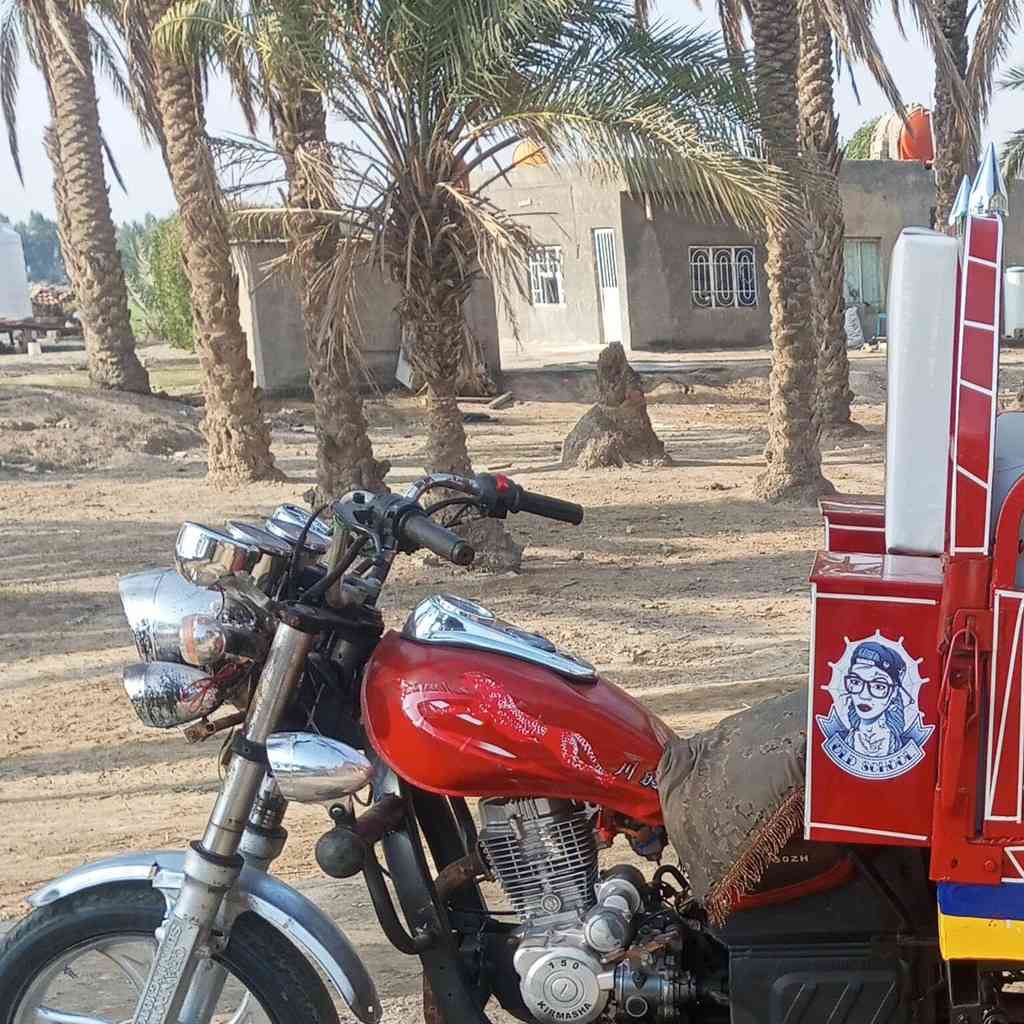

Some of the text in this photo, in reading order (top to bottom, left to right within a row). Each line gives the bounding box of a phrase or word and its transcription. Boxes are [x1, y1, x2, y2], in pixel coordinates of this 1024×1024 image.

[831, 743, 915, 773] OLD SCHOOL
[547, 959, 580, 970] 150
[536, 1000, 593, 1020] KIRMASHA
